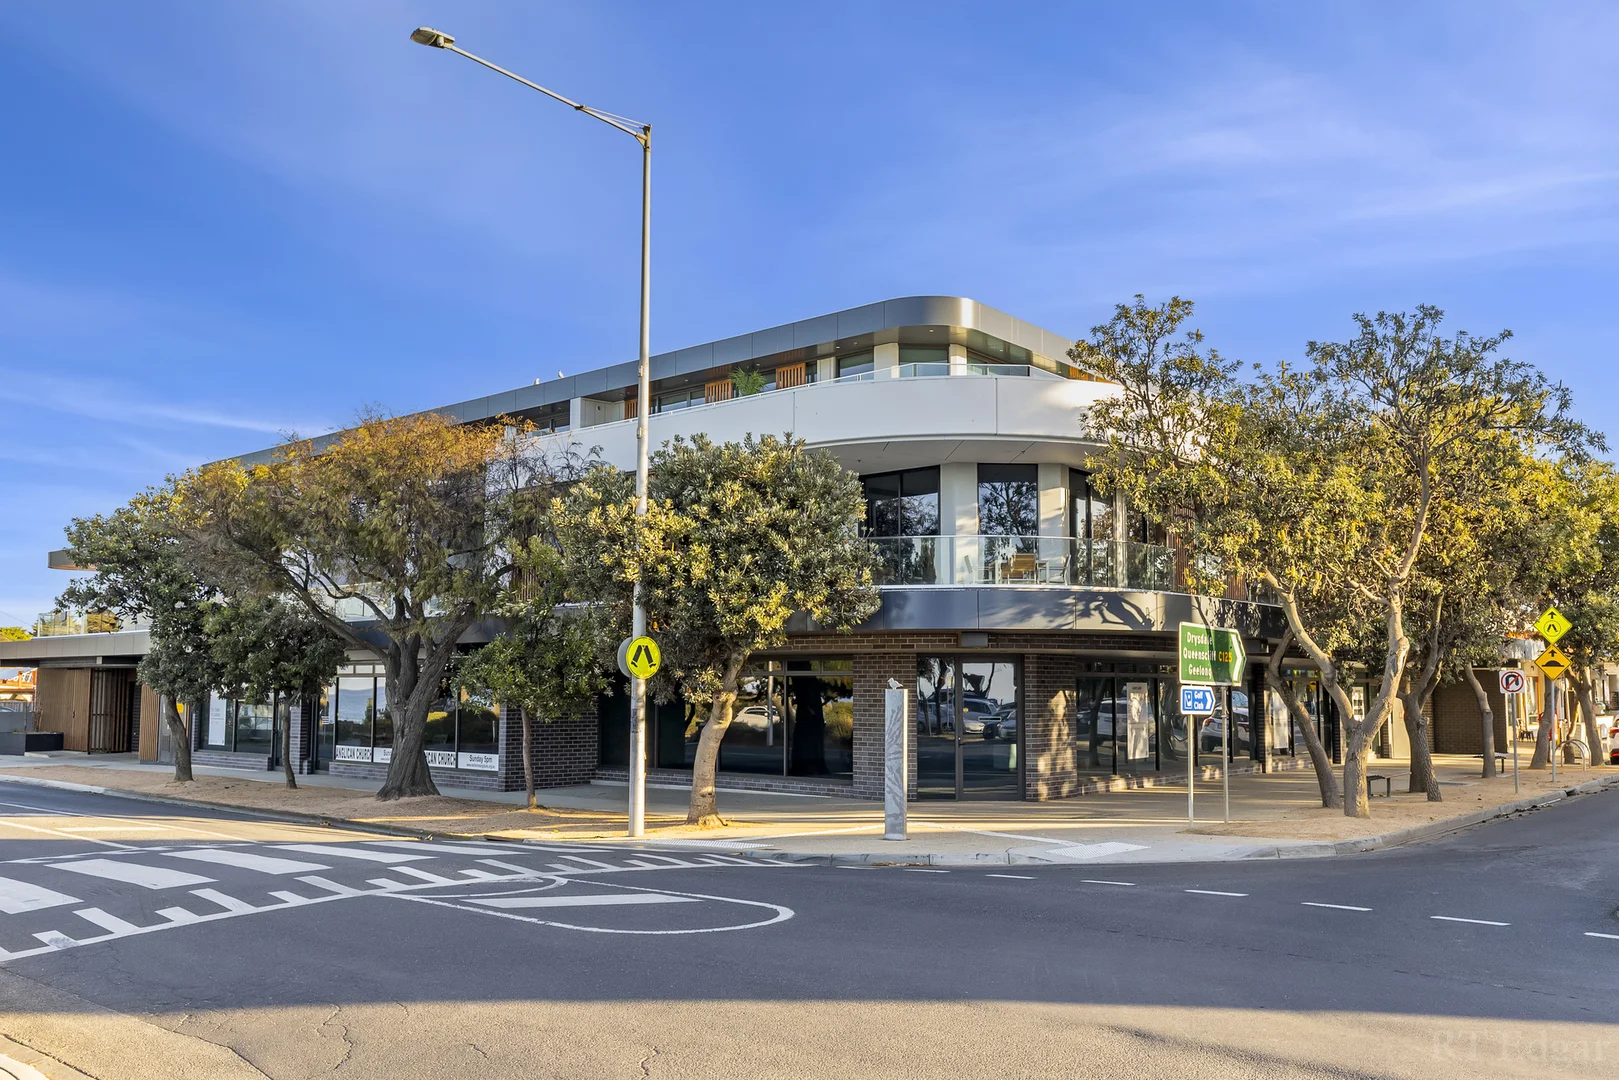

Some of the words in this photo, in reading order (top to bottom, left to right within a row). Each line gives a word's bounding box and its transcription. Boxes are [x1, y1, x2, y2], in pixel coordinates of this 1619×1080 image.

[1186, 632, 1212, 646] Drysdale
[1183, 647, 1217, 661] Queenscliff
[1218, 651, 1233, 662] C125
[1188, 664, 1212, 679] Geelong
[1194, 691, 1203, 699] Golf
[336, 747, 355, 760] ANGLICAN
[469, 754, 483, 764] Sunday
[484, 755, 492, 764] 5pm
